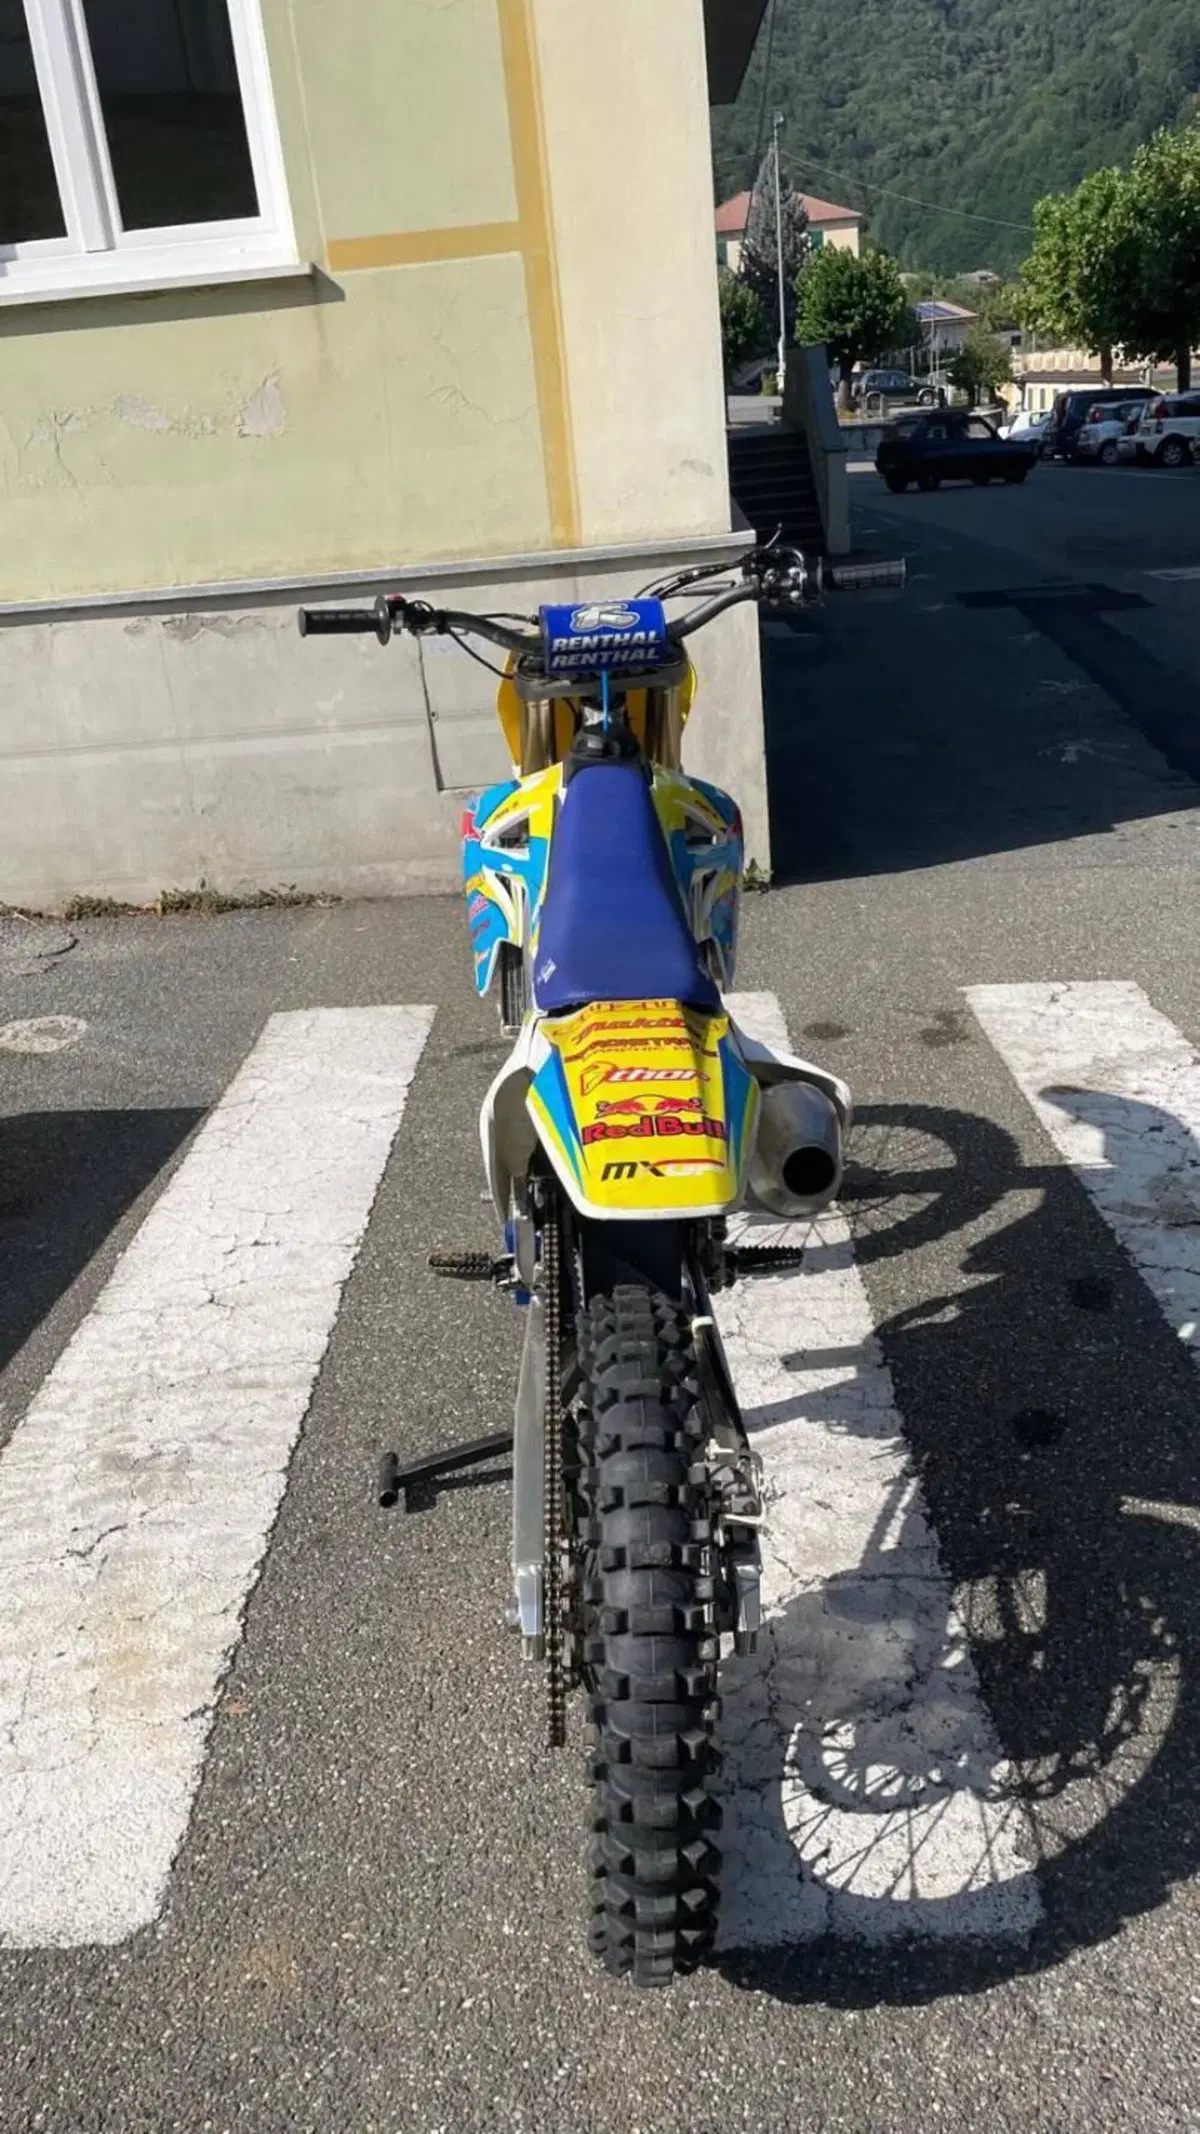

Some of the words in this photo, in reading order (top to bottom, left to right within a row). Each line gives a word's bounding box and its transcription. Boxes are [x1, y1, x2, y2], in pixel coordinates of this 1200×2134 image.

[552, 631, 660, 652] RENTHAL
[551, 648, 659, 668] RENTHAL
[582, 1115, 654, 1145] Red
[655, 1115, 726, 1140] Bull
